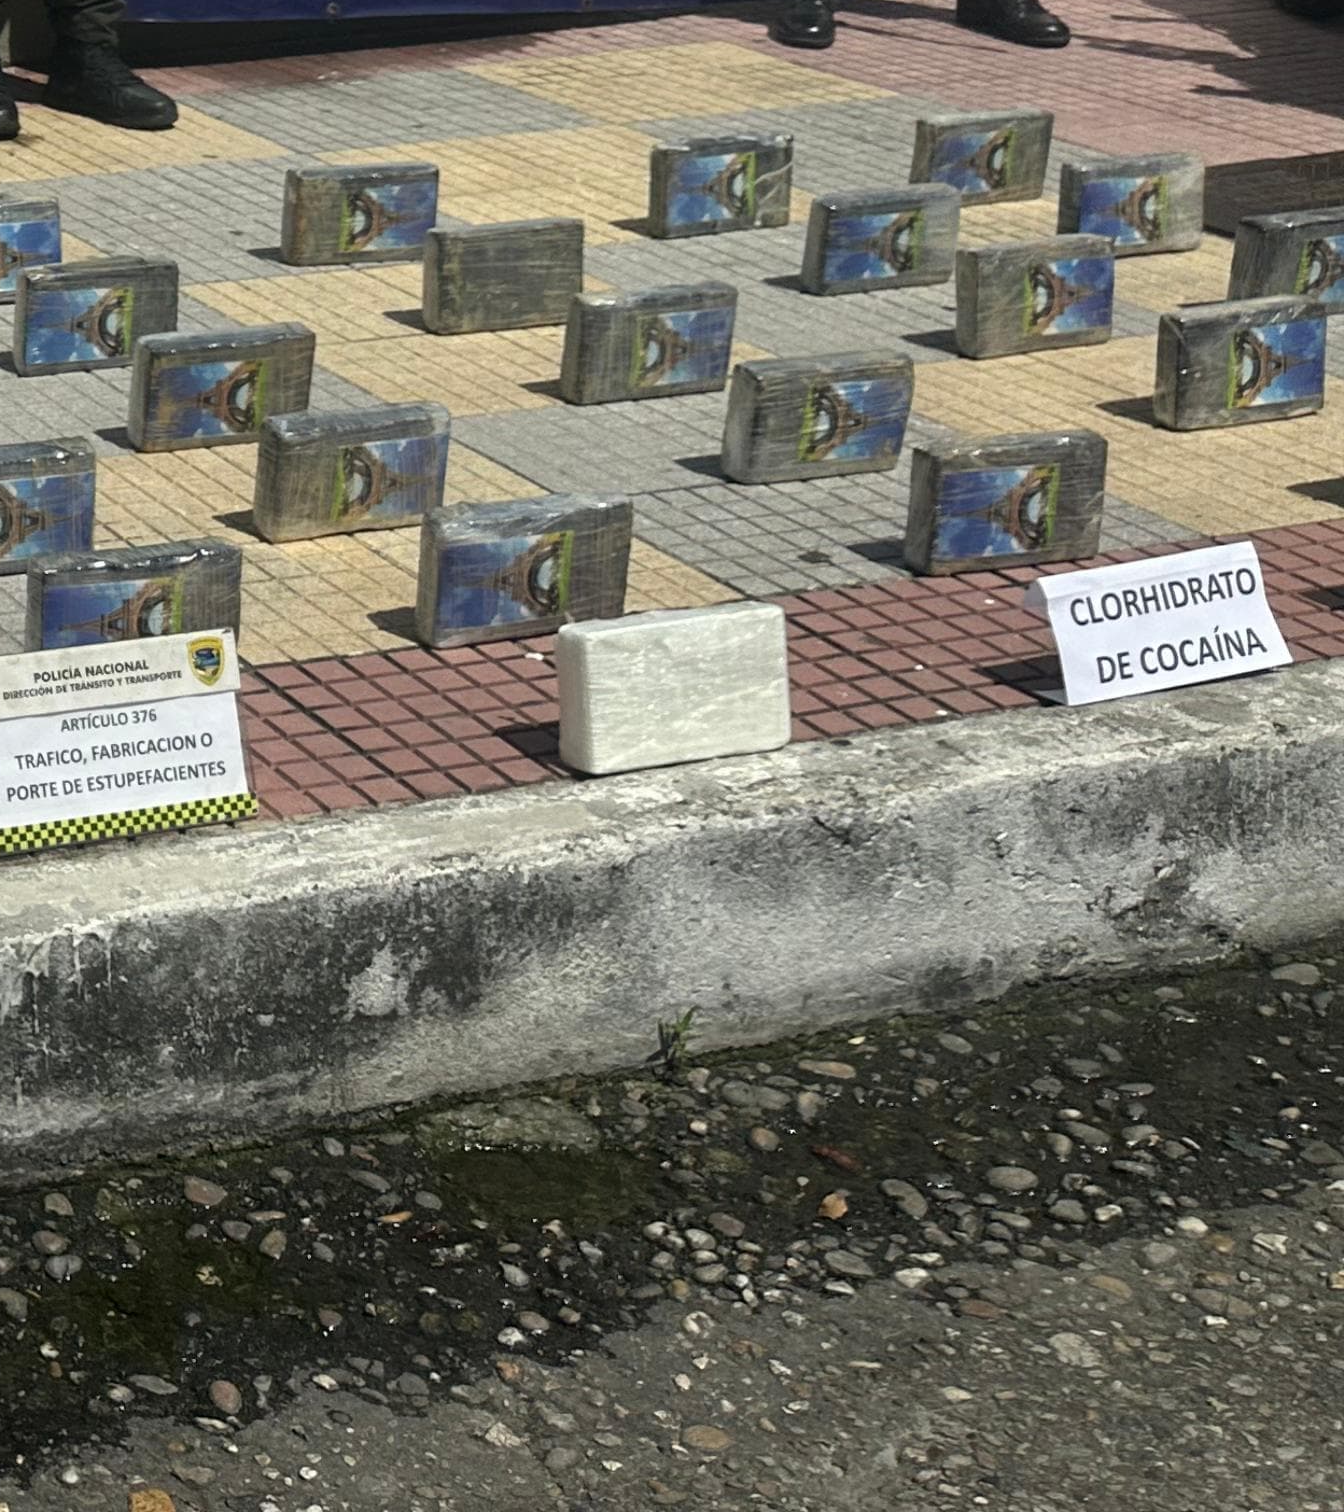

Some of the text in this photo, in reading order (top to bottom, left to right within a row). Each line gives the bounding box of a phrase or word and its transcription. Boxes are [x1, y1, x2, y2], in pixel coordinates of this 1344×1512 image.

[1070, 568, 1256, 626] CLORHIDRATO
[33, 660, 149, 684] POLICÍA NACIONAL
[1097, 626, 1267, 683] DE COCAÍNA
[60, 709, 157, 733] ARTÍCULO 376
[15, 733, 213, 770] TRAFICO, FABRICACION O
[6, 761, 226, 802] PORTE DE ESTUPEFACIENTES
